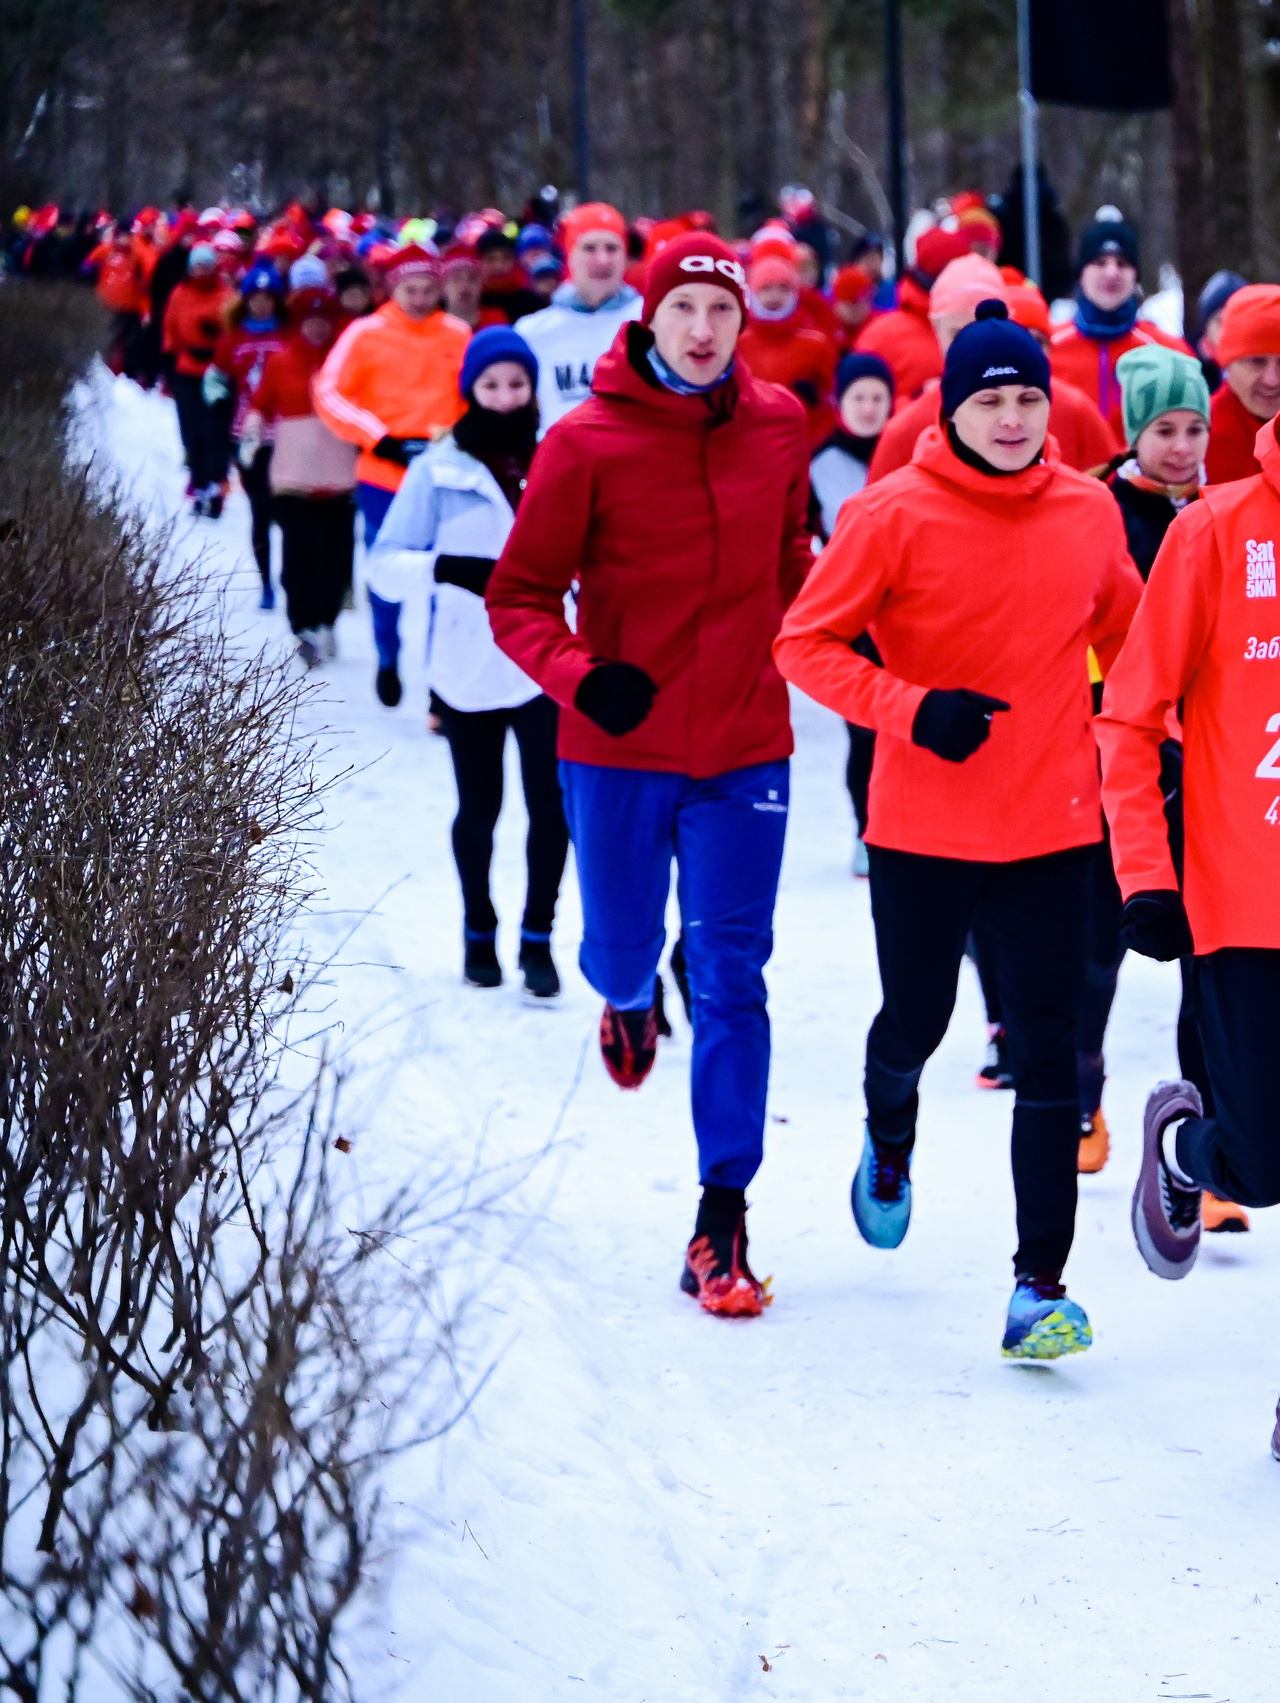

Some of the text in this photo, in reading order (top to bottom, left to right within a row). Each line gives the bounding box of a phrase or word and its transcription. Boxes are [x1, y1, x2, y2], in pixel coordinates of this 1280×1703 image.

[1246, 539, 1275, 562] Sat
[1247, 561, 1276, 580] 9AM
[1246, 579, 1277, 598] 5KM
